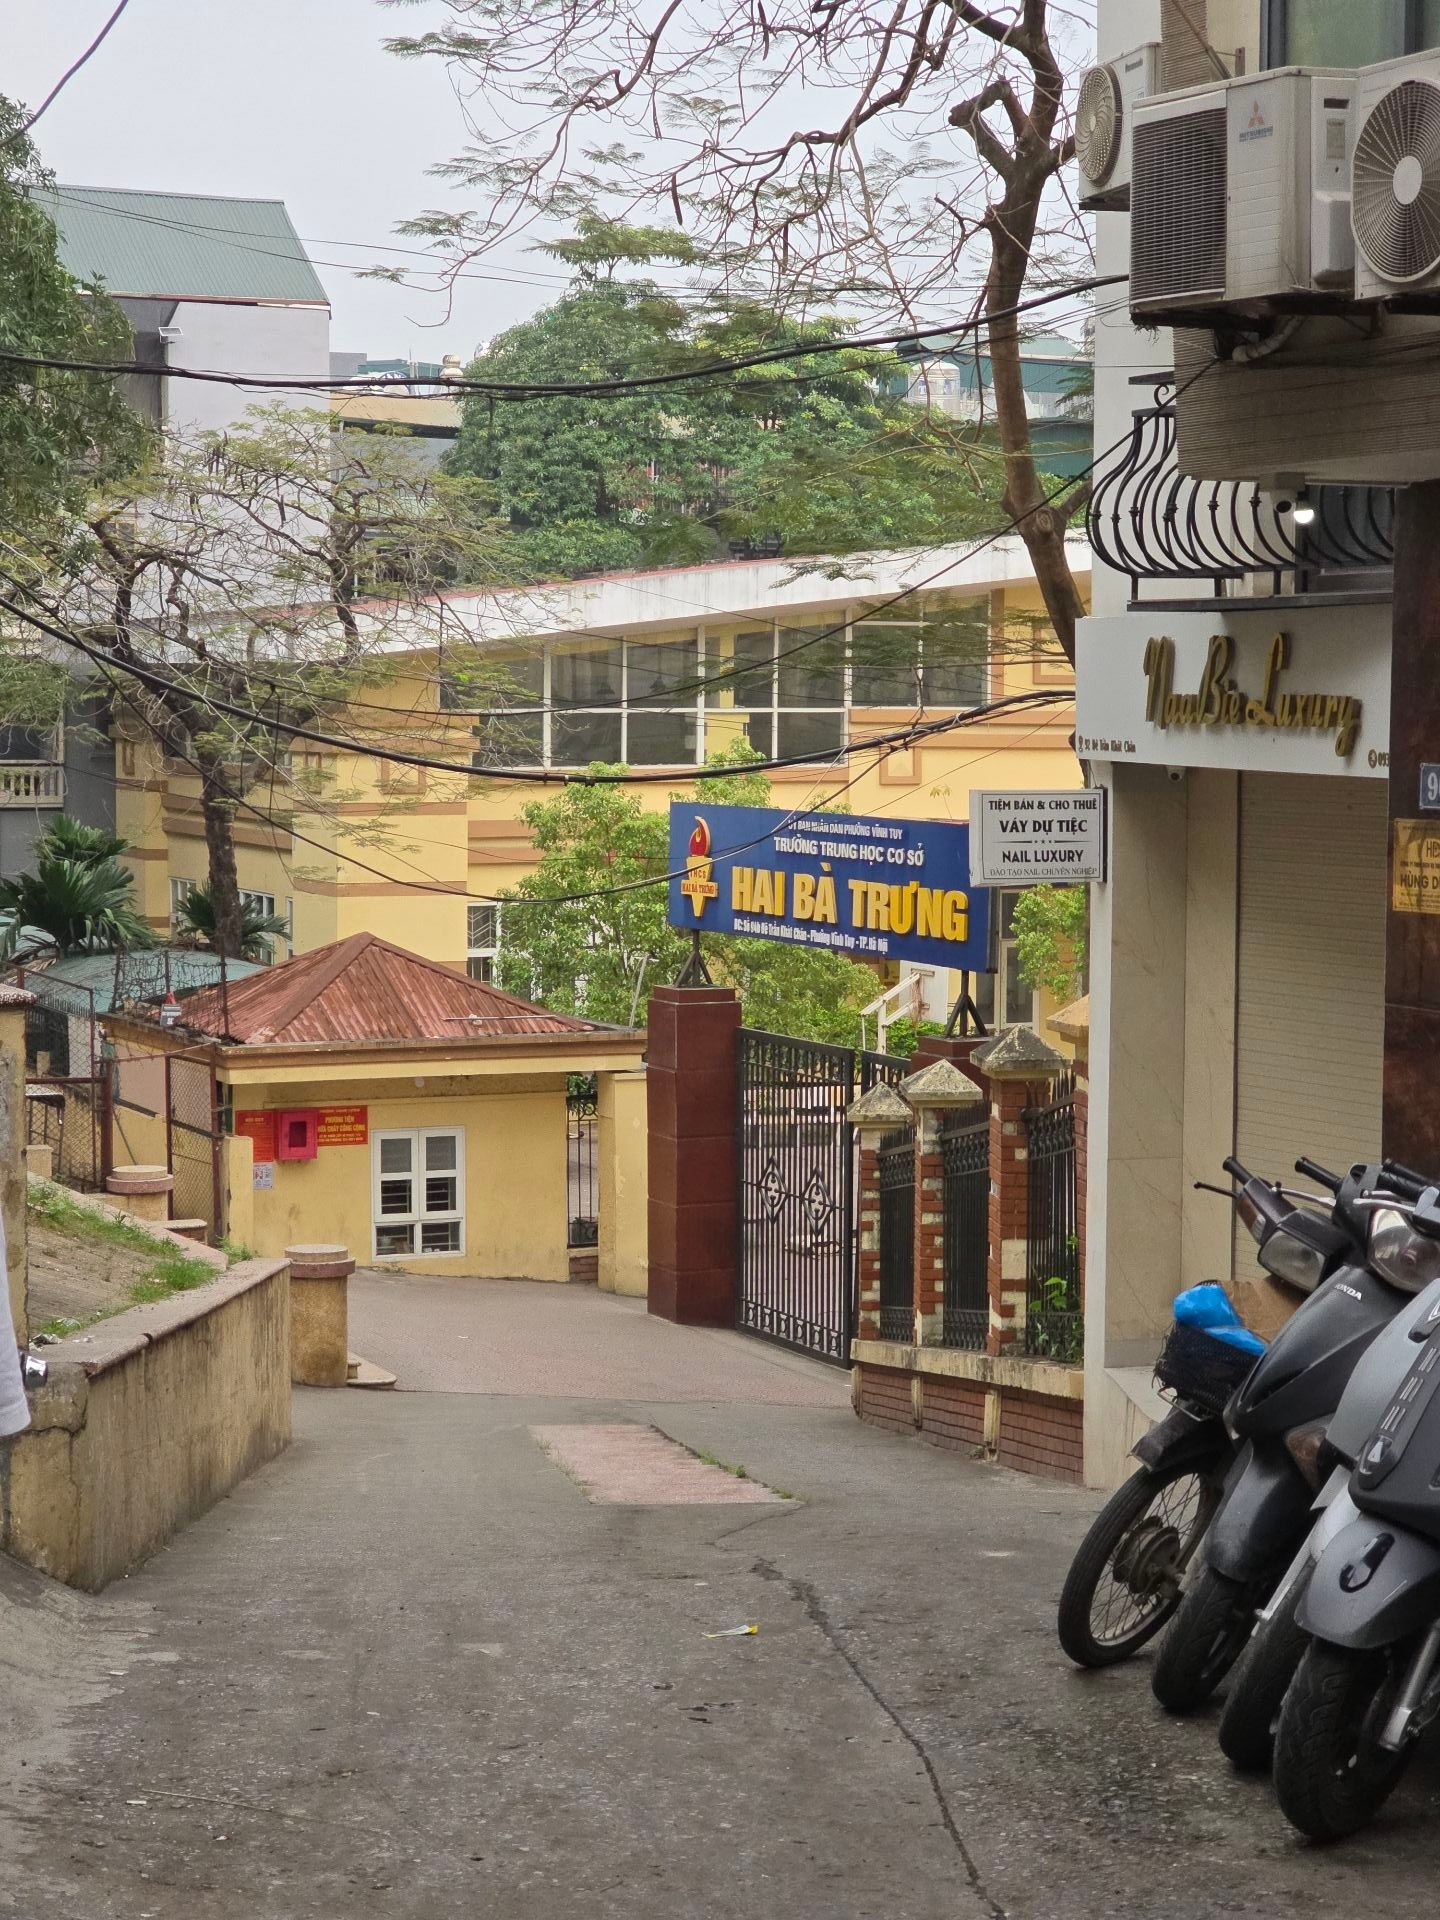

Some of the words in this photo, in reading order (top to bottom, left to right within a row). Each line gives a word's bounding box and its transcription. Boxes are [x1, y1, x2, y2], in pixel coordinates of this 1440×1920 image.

[1245, 632, 1361, 757] Luxury
[1427, 772, 1440, 800] 9
[989, 799, 1011, 812] TIỆM
[1014, 798, 1034, 810] BÁN
[1037, 800, 1045, 810] &
[1048, 800, 1069, 810] CHO
[1073, 798, 1097, 810] THUÊ
[889, 828, 903, 840] TUY
[1000, 818, 1028, 833] VÁY
[1032, 819, 1054, 835] DỰ
[1057, 817, 1088, 835] TIỆC
[774, 834, 818, 855] TRƯỜNG
[820, 841, 857, 859] TRUNG
[860, 844, 884, 865] HỌC
[887, 847, 905, 864] CƠ
[907, 843, 925, 866] SỞ
[1002, 850, 1031, 863] NAIL
[1034, 849, 1084, 863] LUXURY
[1023, 868, 1038, 876] NAIL
[1042, 867, 1070, 876] CHUYÊN
[1400, 871, 1429, 889] HÙNG
[1432, 876, 1440, 889] D
[732, 866, 785, 916] HAI
[793, 862, 837, 924] BÀ
[848, 879, 968, 941] TRƯNG
